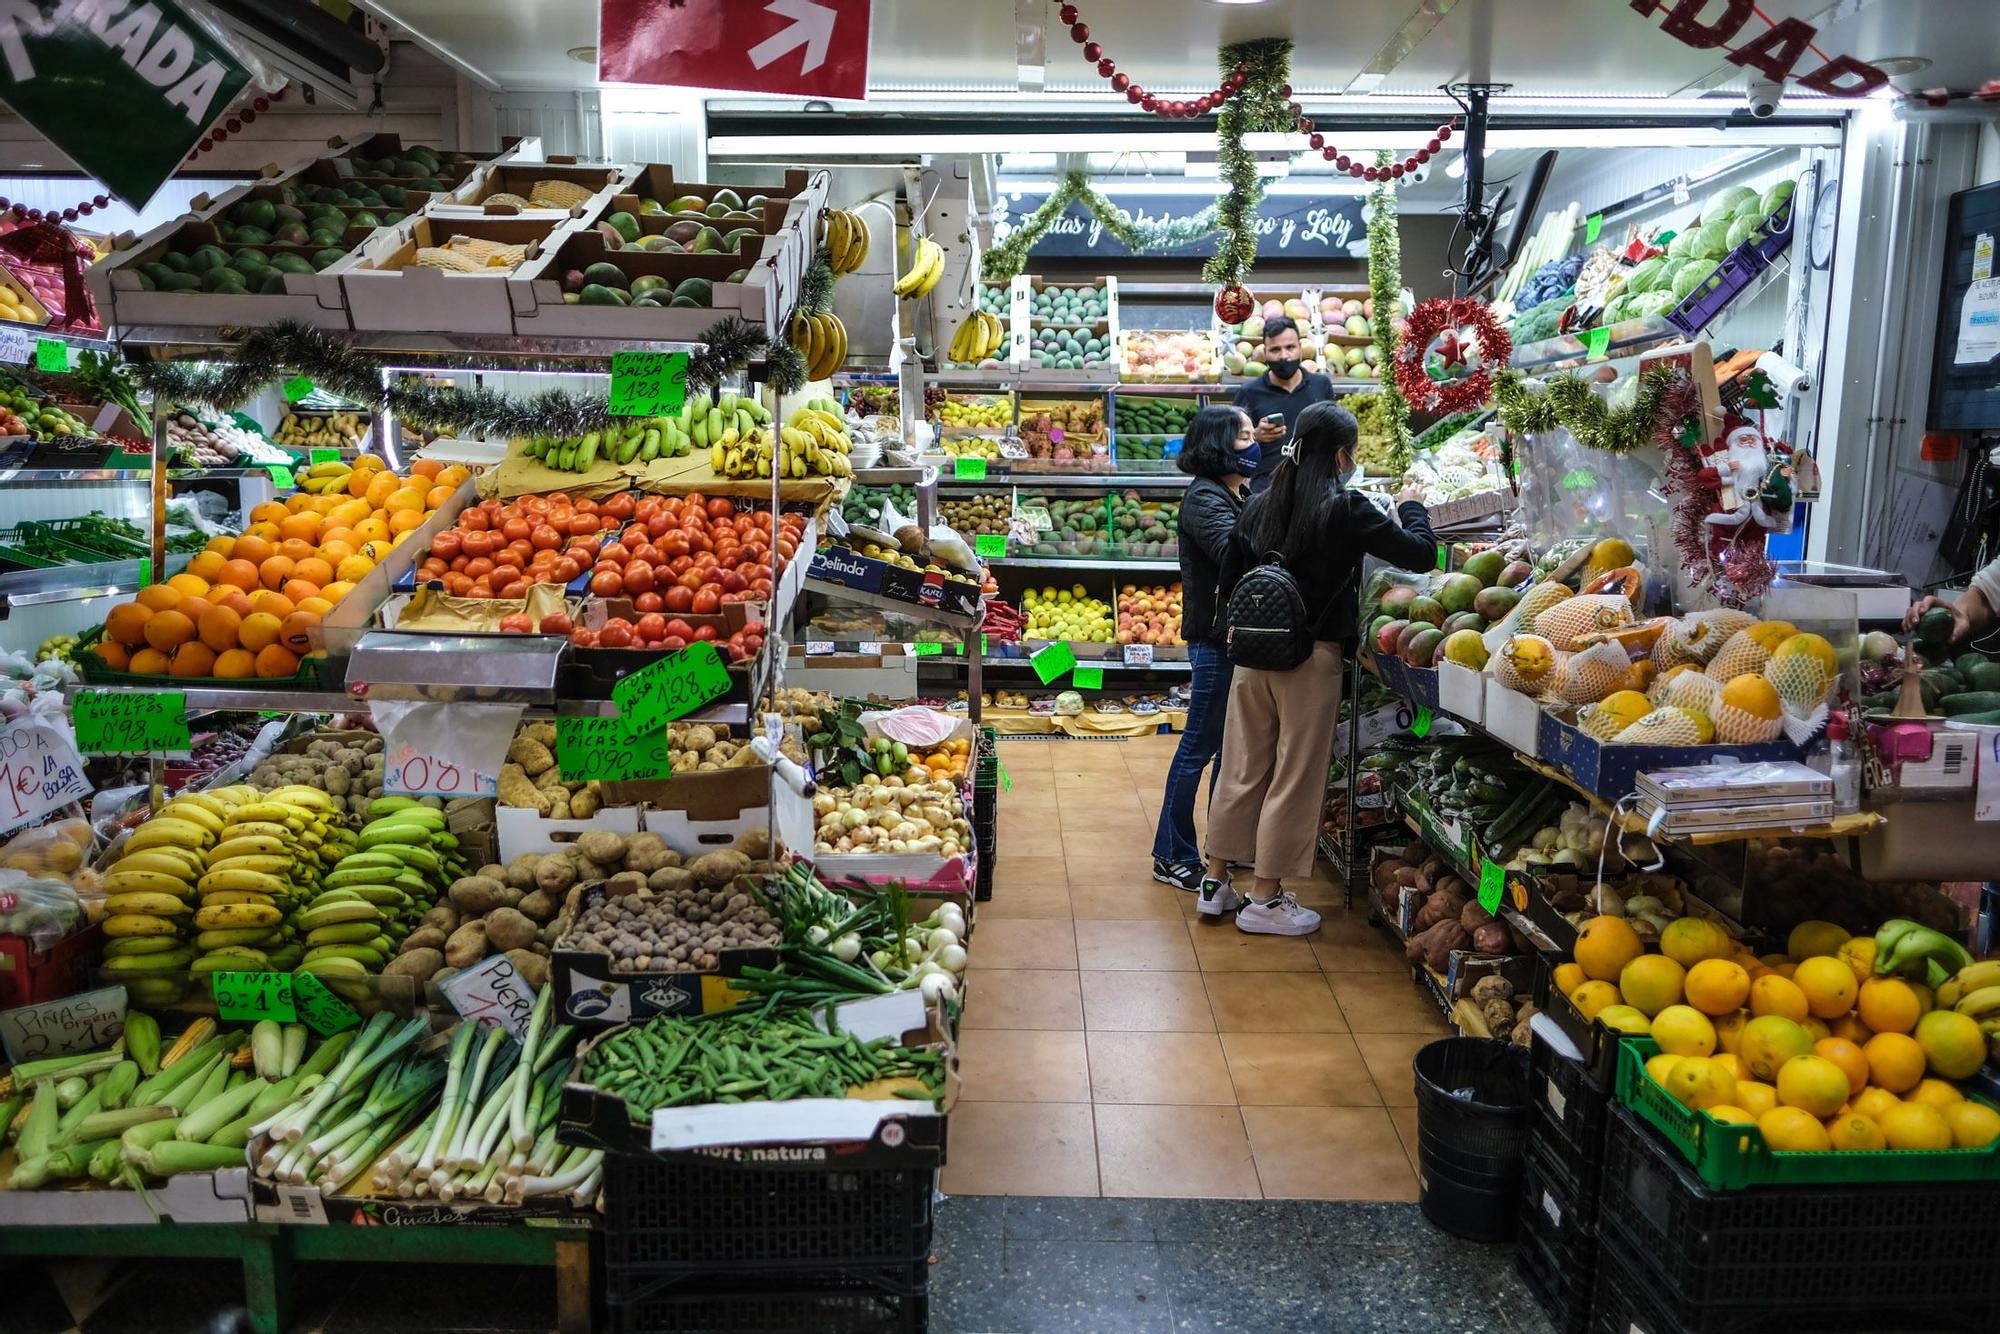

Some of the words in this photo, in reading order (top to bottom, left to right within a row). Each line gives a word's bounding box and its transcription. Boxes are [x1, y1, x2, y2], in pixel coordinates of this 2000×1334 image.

[1630, 0, 1890, 98] DAD
[1280, 217, 1297, 248] y
[1301, 208, 1353, 248] Loly
[614, 353, 673, 364] TOMATE
[613, 366, 662, 379] SALSA
[811, 554, 867, 577] Melinda
[919, 586, 943, 599] KANZI
[617, 650, 689, 692] TOMATE
[74, 693, 156, 710] PLATANOS
[622, 683, 653, 720] SALSA
[560, 719, 620, 735] PAPAS
[36, 733, 48, 749] A
[43, 755, 57, 776] LA
[42, 765, 78, 801] BOLSA
[14, 1001, 98, 1037] PIÑAS
[383, 1206, 468, 1227] Guedes
